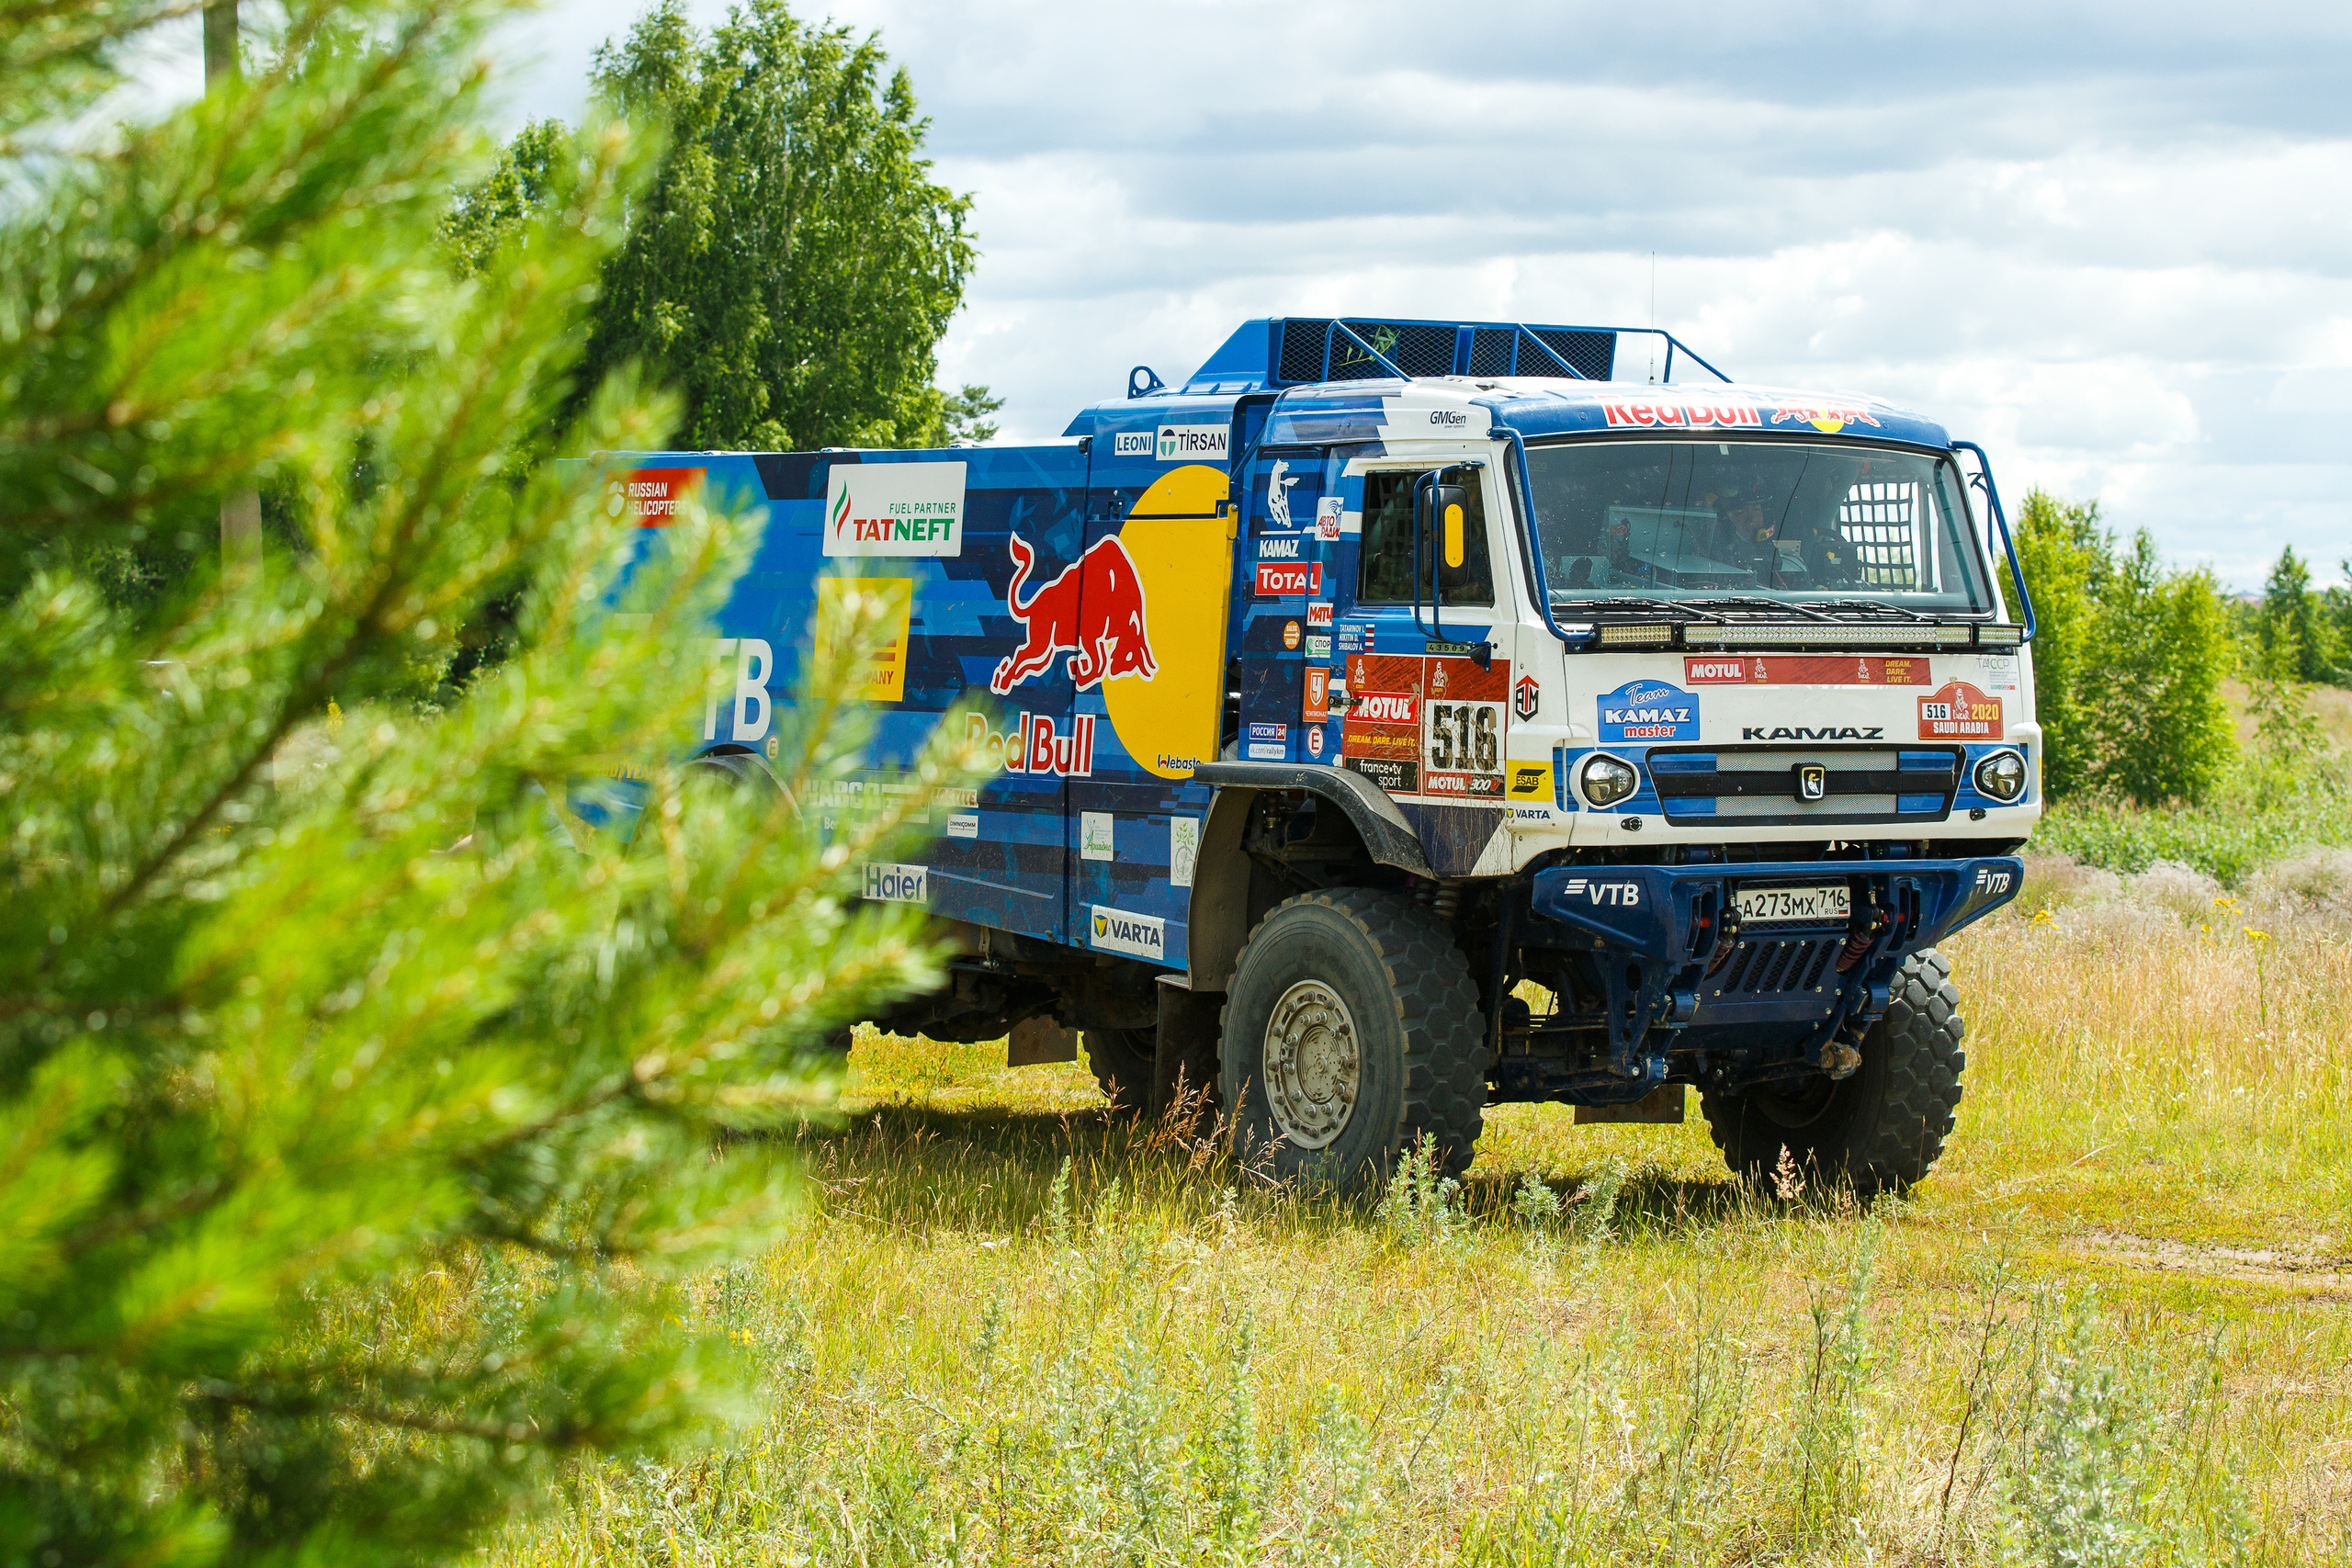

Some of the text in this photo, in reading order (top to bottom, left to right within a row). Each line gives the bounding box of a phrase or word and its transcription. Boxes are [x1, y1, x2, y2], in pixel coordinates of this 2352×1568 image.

[1430, 411, 1467, 424] GMGen
[1116, 435, 1152, 451] LEONI
[628, 482, 668, 498] RUSSIAN
[627, 500, 688, 515] HELICOPTERS
[889, 502, 956, 514] FUEL PARTNER
[853, 518, 956, 541] TATNEFT
[1259, 539, 1300, 558] KAMAZ
[1690, 663, 1742, 678] MOTUL
[1885, 660, 1912, 668] DREAM.
[1886, 675, 1912, 683] LIVE IT.
[695, 638, 774, 741] TB
[1625, 683, 1669, 706] Team
[1352, 695, 1412, 720] MOTUL
[1927, 704, 1947, 719] 516
[1971, 704, 1999, 720] 2020
[1604, 707, 1691, 725] KAMAZ
[1252, 727, 1285, 737] РОССИЯ 24
[1624, 724, 1676, 738] master
[1741, 727, 1883, 740] KAMAZ
[1933, 721, 1989, 734] SAUDI ARABIA
[1029, 714, 1096, 777] Bull
[1348, 734, 1372, 744] DREAM.
[1373, 736, 1391, 745] DARE.
[1392, 738, 1408, 746] LIVE
[1431, 705, 1498, 771] 516
[1378, 776, 1401, 790] sport
[1427, 775, 1466, 791] MOTUL
[1516, 775, 1539, 786] ESAB
[1516, 808, 1551, 819] VARTA
[865, 866, 922, 900] Haier
[1984, 873, 2010, 895] VTB
[1588, 884, 1639, 906] VTB
[1818, 889, 1846, 908] 716
[1111, 919, 1161, 947] VARTA
